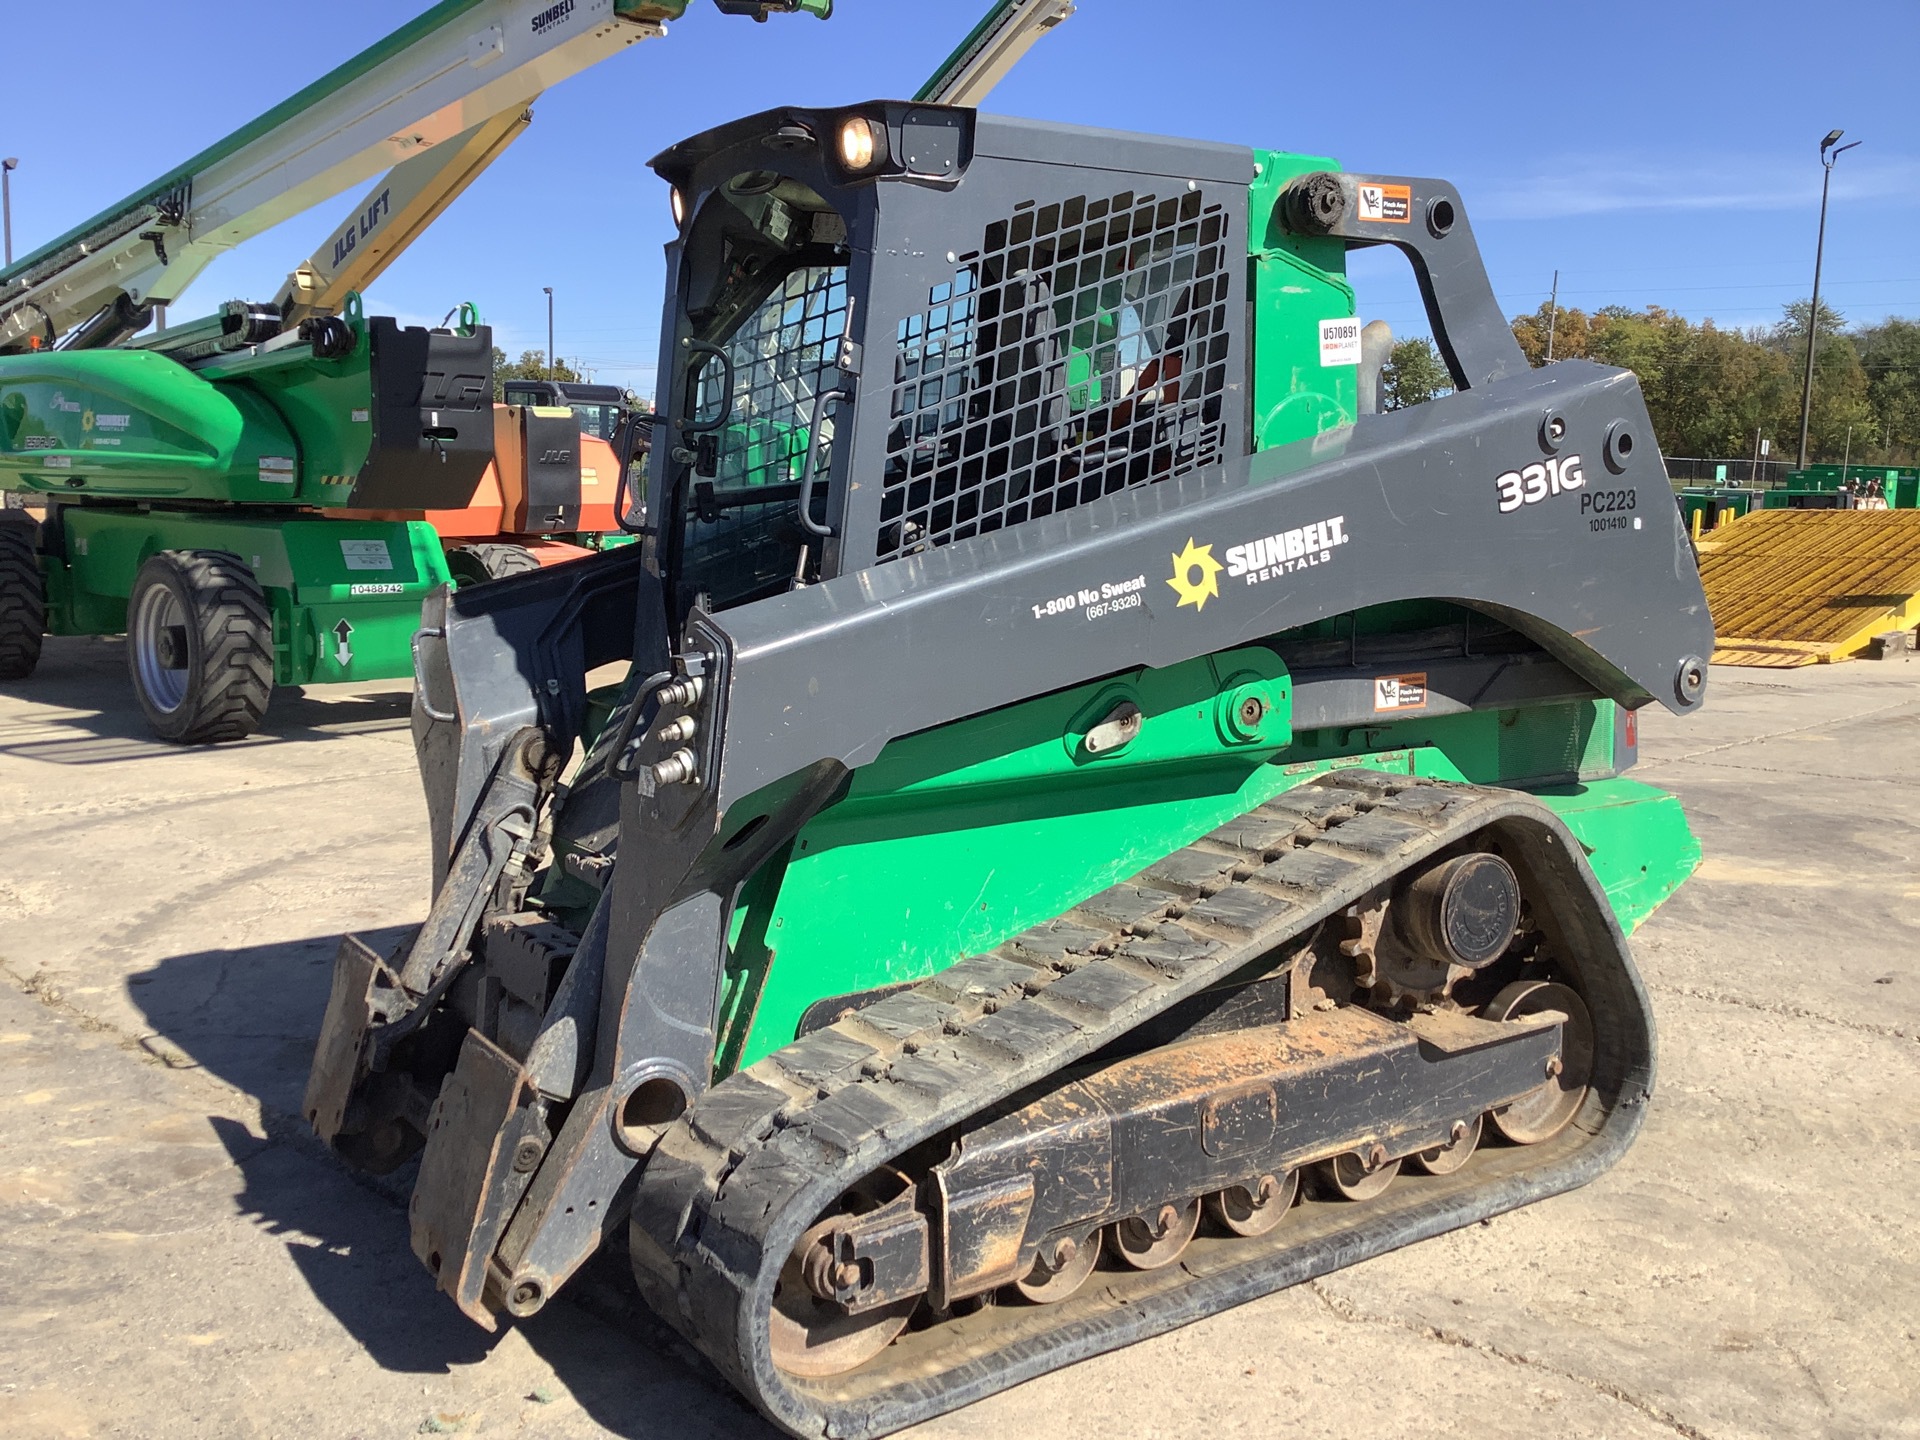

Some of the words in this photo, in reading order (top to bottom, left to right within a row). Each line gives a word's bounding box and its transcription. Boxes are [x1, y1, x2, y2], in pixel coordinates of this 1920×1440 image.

[531, 0, 574, 32] SUNBELT
[538, 14, 570, 36] RENTALS
[332, 225, 356, 269] JLG
[360, 187, 390, 240] LIFT
[1323, 325, 1357, 340] U570891
[1323, 341, 1358, 350] IRONPLANET
[539, 449, 571, 465] JLG
[1496, 454, 1583, 514] 331G
[1581, 489, 1636, 515] PC223
[1589, 516, 1628, 532] 1001410
[1225, 515, 1344, 578] SUNBELT
[1246, 549, 1331, 586] RENTALS
[352, 584, 403, 594] 10488742
[1031, 594, 1076, 619] 1-800
[1077, 589, 1099, 606] No
[1101, 574, 1147, 599] Sweat
[1086, 591, 1142, 621] (667-9328)
